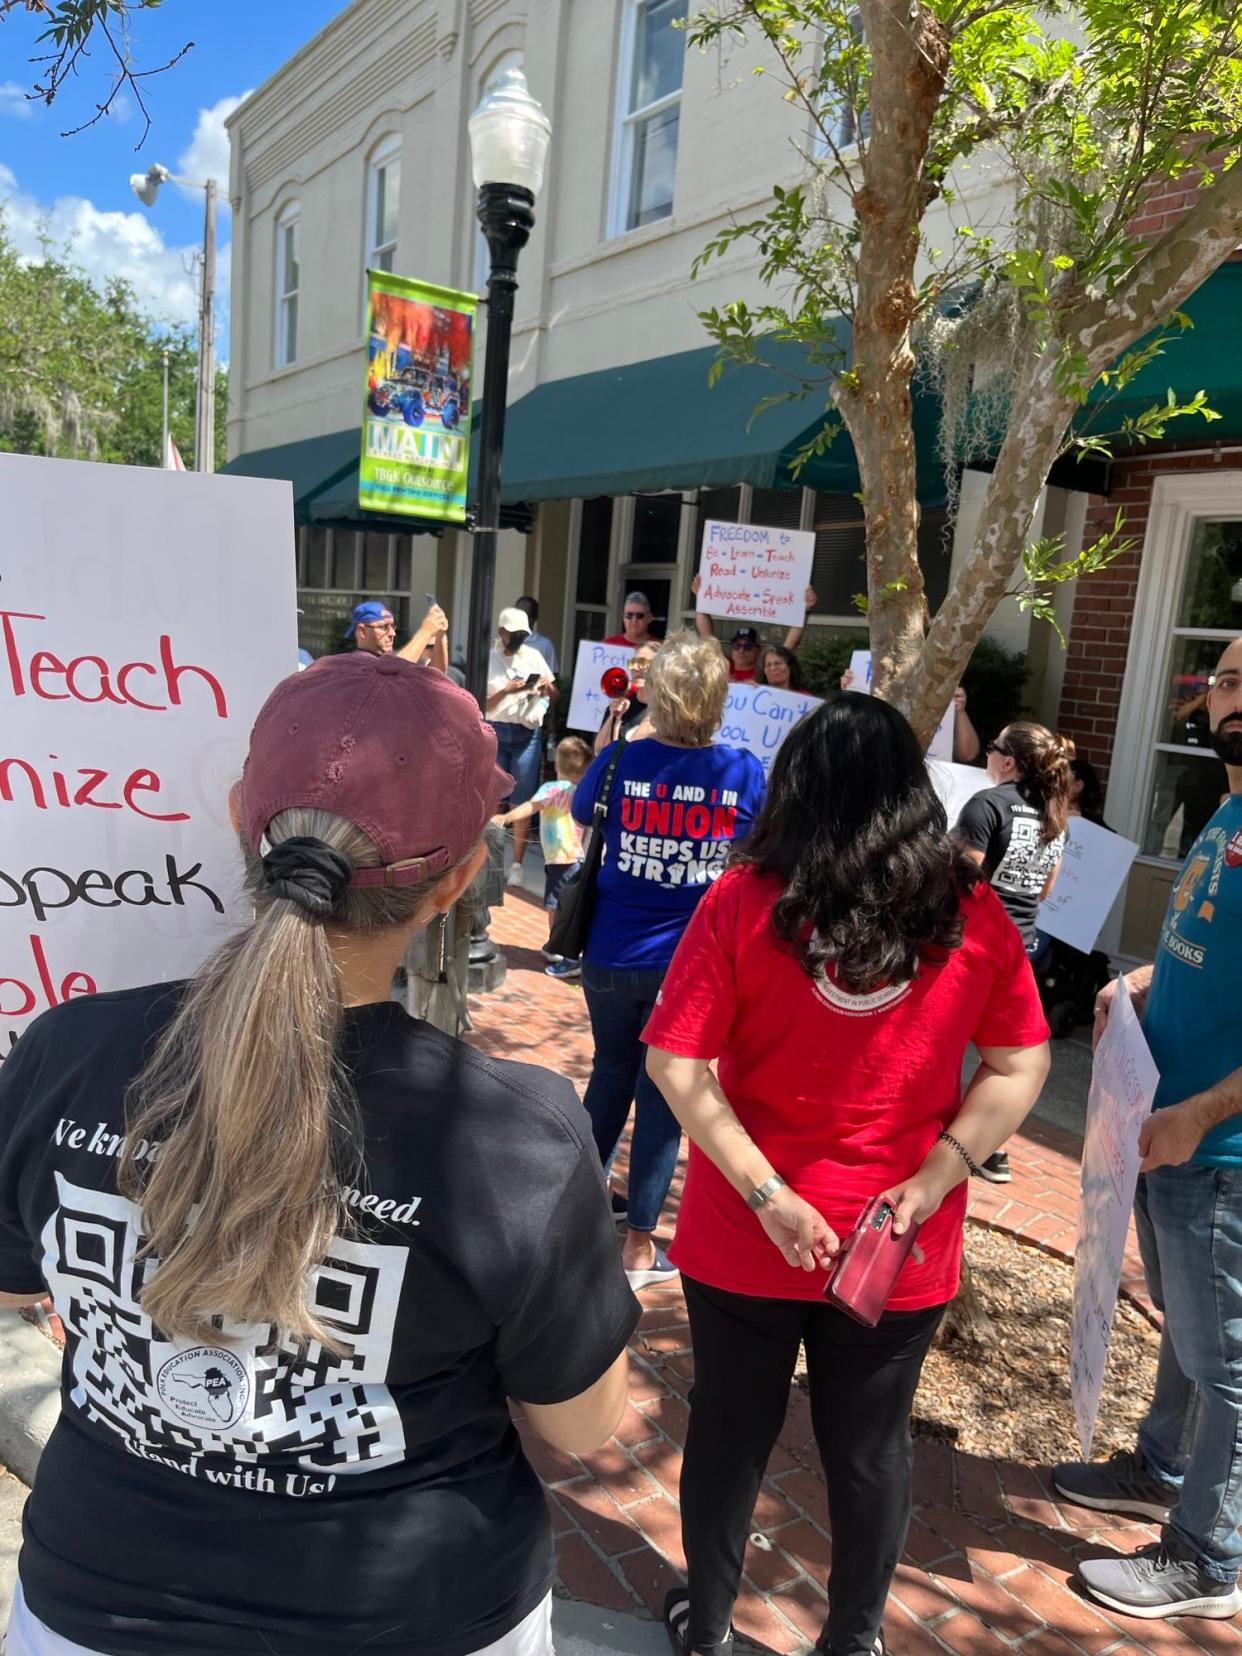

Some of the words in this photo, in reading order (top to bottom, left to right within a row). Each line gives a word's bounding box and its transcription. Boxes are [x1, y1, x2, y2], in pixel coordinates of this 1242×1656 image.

[371, 424, 458, 463] MAIN
[710, 525, 769, 544] FREEDOM
[780, 533, 791, 546] to
[706, 546, 718, 560] Be
[766, 549, 796, 562] Teach
[710, 563, 736, 577] Read
[751, 566, 790, 580] Unionize
[704, 585, 751, 601] Advocate
[762, 588, 795, 606] Speak
[726, 603, 777, 618] Assemble
[0, 610, 228, 719] Teach
[592, 646, 626, 666] Prot
[726, 695, 748, 711] ou
[720, 726, 751, 742] OOL
[0, 754, 191, 822] nize
[623, 780, 650, 798] THE
[656, 783, 668, 798] U
[672, 785, 705, 802] AND
[711, 788, 718, 803] I
[721, 789, 738, 807] IN
[621, 797, 738, 840] UNION
[620, 832, 694, 862] KEEPS
[700, 840, 732, 860] US
[1168, 936, 1204, 964] BOOKS
[340, 1185, 423, 1226] need.
[162, 1351, 200, 1378] EDUCATION
[202, 1349, 246, 1382] ASSOCIATION
[206, 1377, 227, 1387] PEA
[170, 1396, 197, 1407] Protect
[175, 1404, 206, 1415] Educate
[181, 1411, 217, 1422] Advocate
[204, 1464, 275, 1494] with
[286, 1474, 336, 1497] Us!
